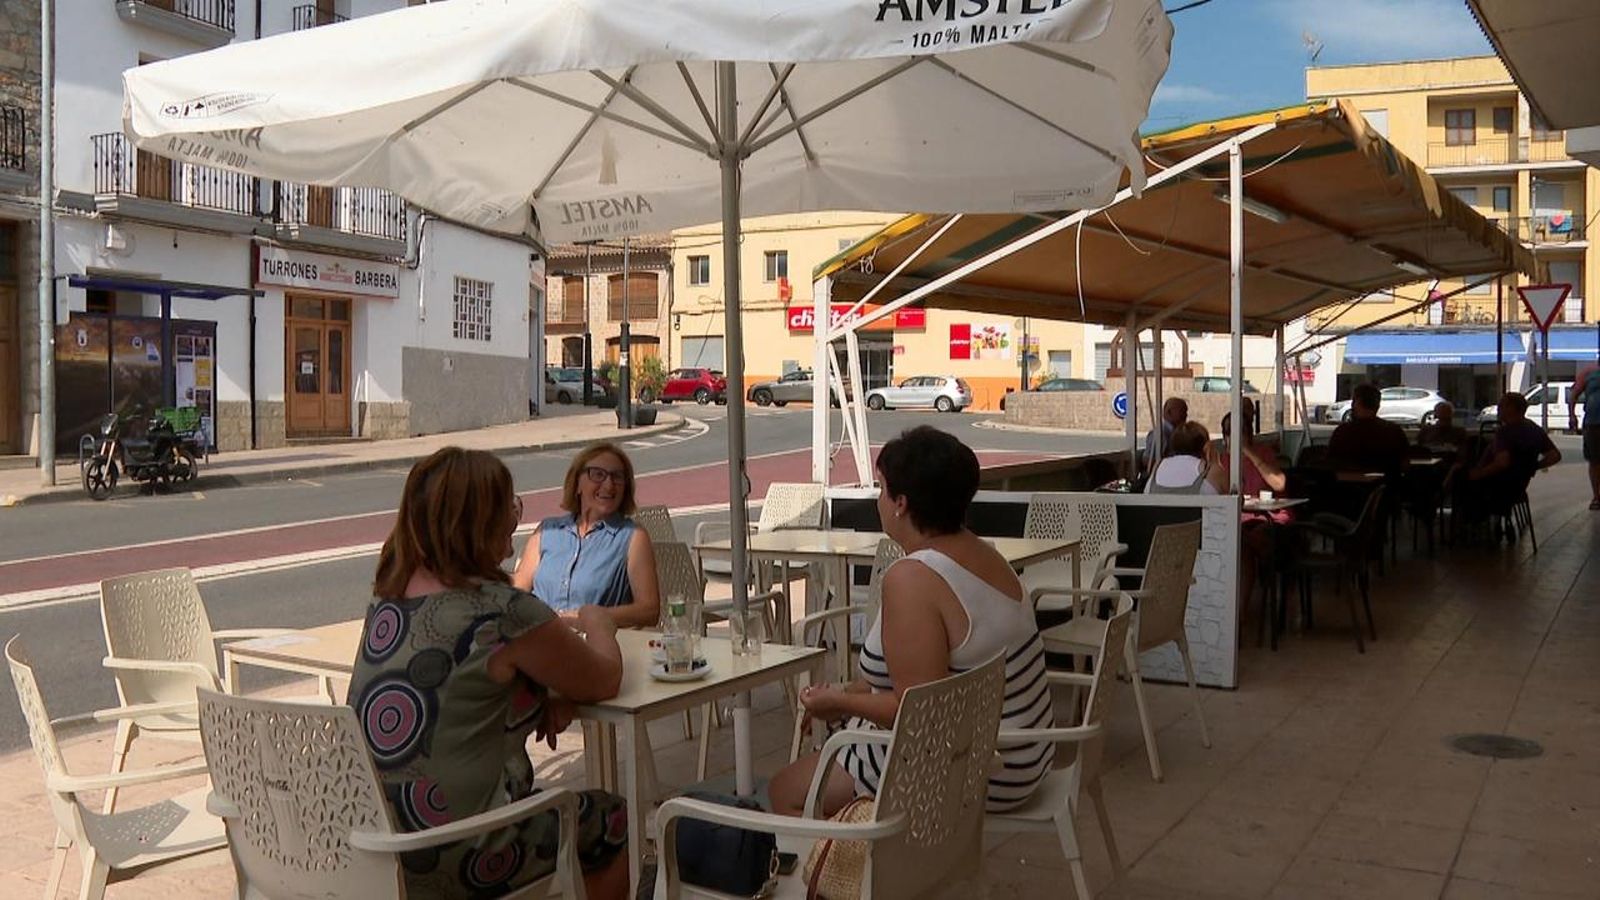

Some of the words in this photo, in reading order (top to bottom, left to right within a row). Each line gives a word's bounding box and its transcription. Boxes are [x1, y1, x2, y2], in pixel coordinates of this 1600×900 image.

[875, 0, 1063, 21] AMS
[911, 27, 960, 48] 100%
[970, 24, 1030, 44] MALT
[263, 259, 318, 279] TURRONES
[790, 309, 862, 328] chtr
